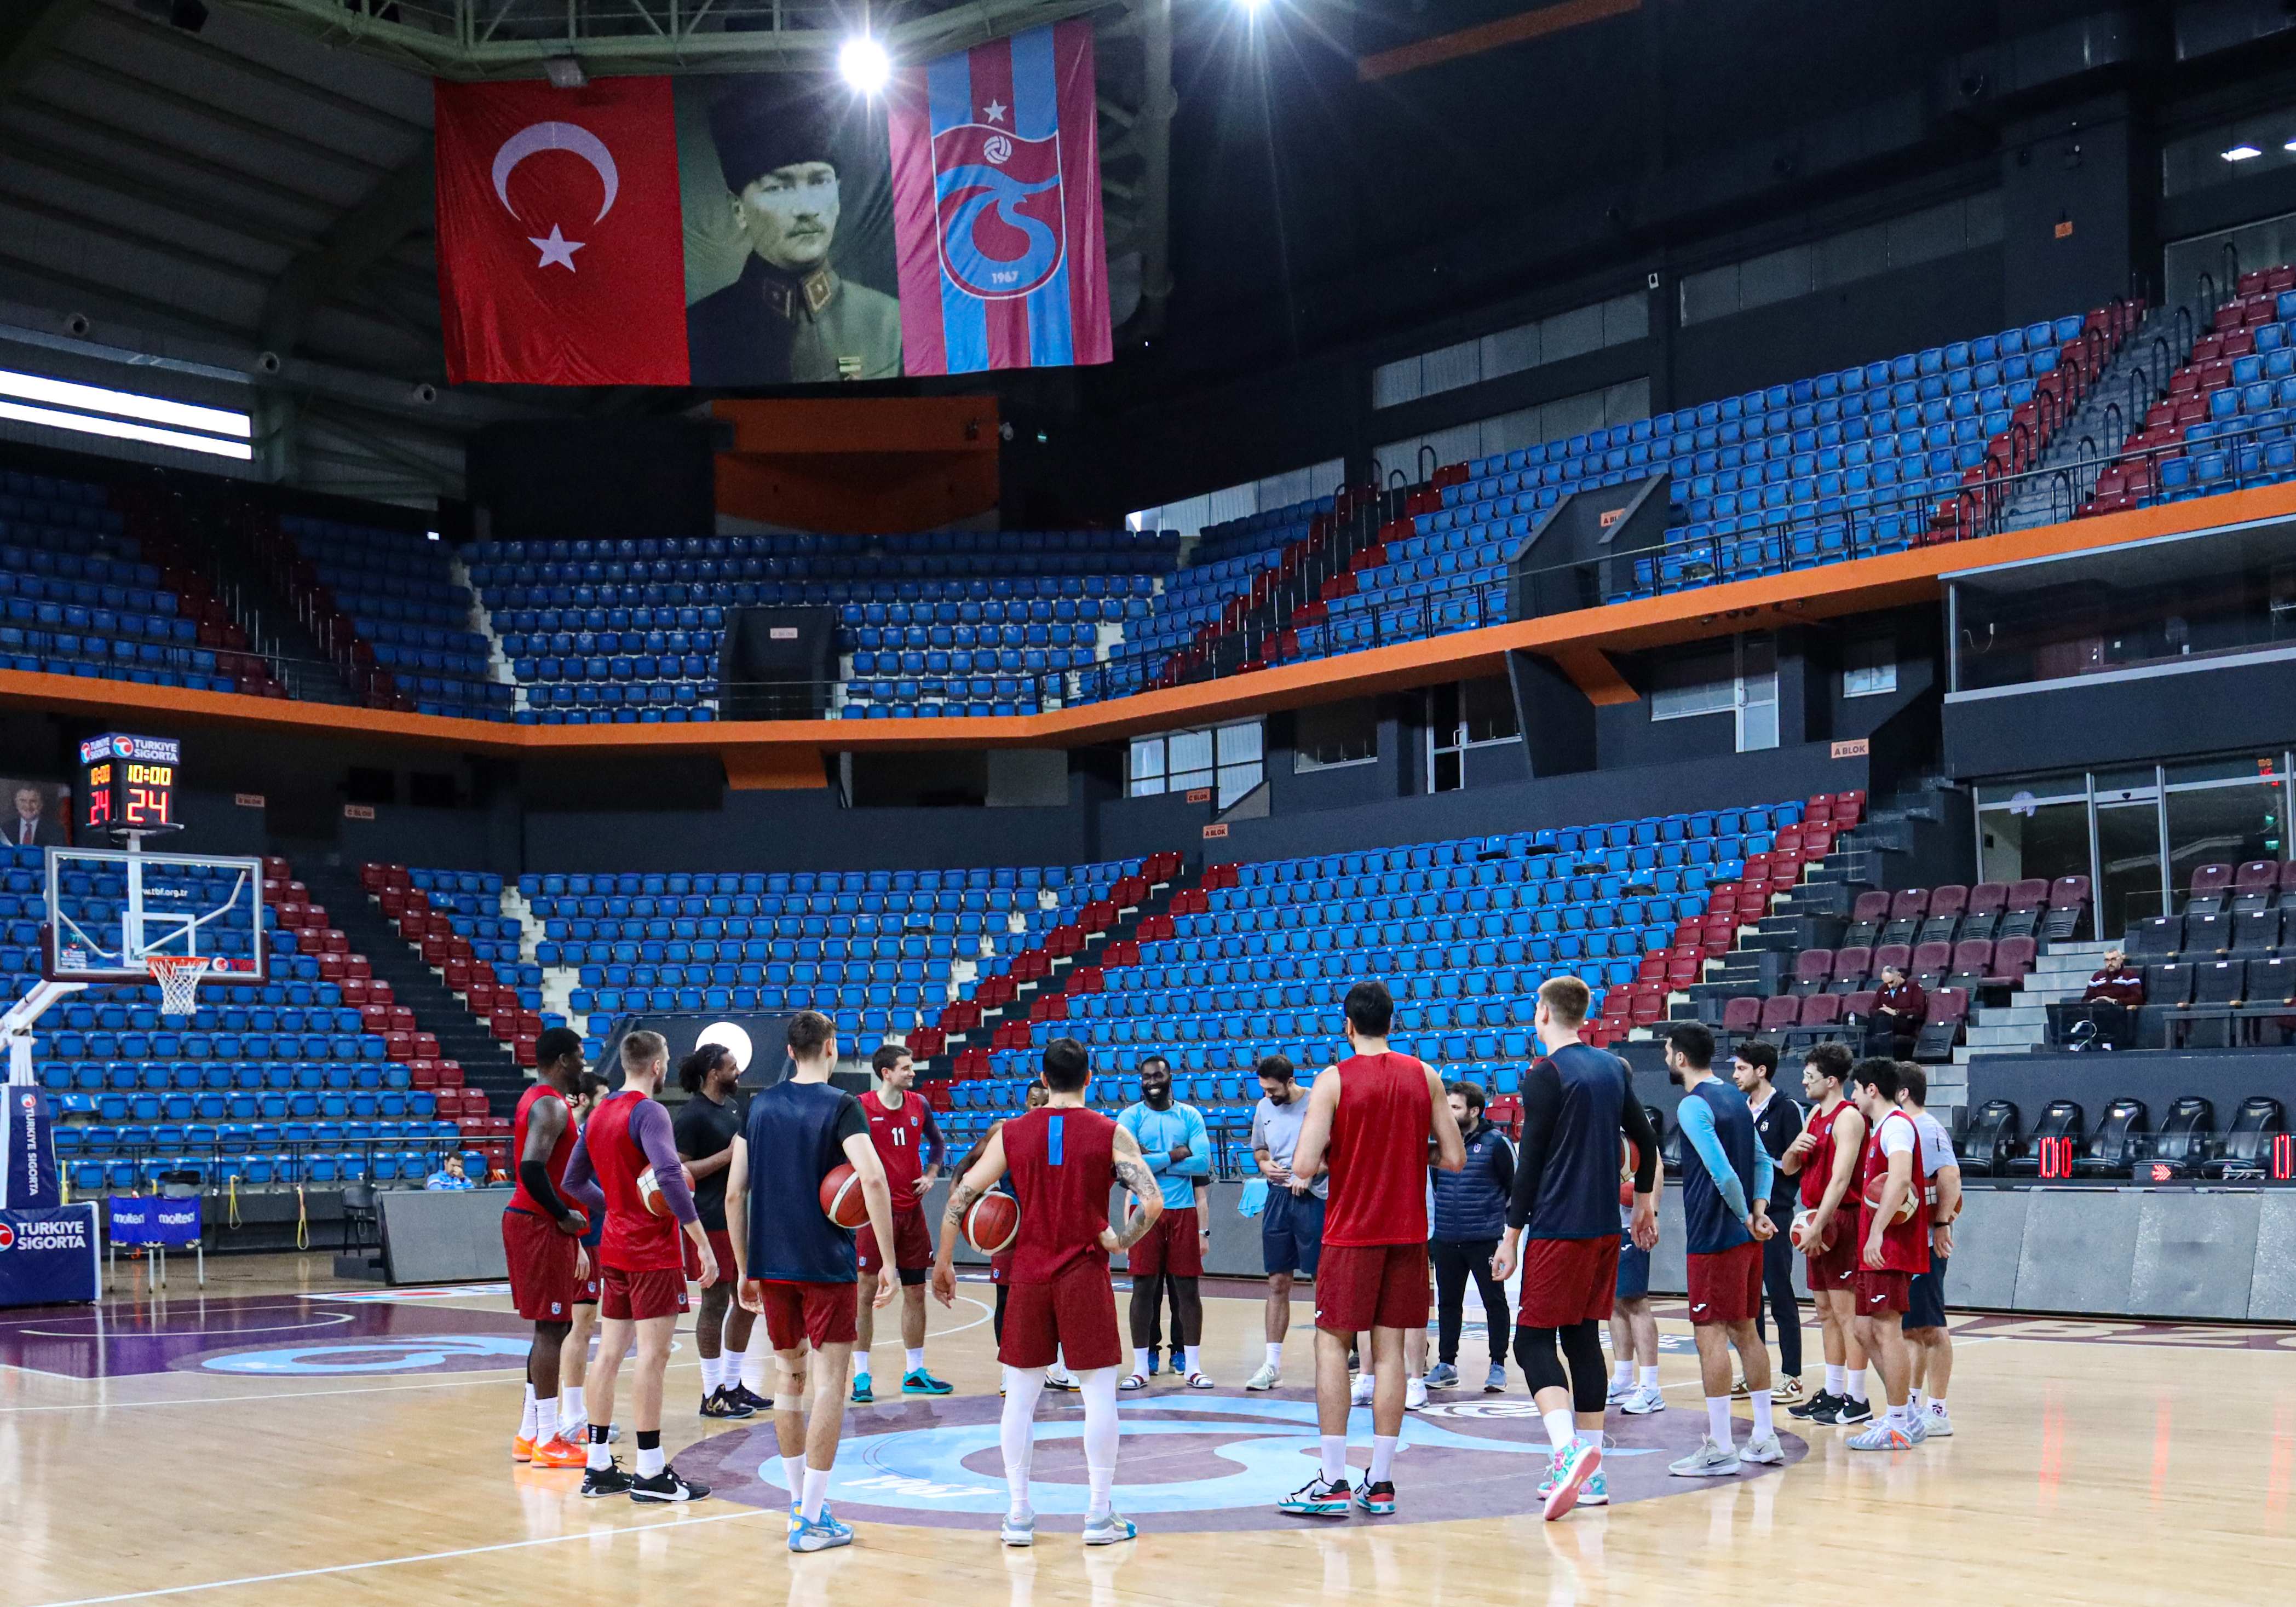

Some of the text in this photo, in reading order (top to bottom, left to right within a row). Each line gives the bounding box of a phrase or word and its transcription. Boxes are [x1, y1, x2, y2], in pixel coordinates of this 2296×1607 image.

[992, 270, 1018, 284] 1967
[1843, 745, 1866, 754] BLOK
[128, 764, 171, 786] 10:00
[89, 789, 110, 825] 24
[126, 788, 168, 823] 24
[891, 1127, 906, 1146] 11
[113, 1212, 145, 1224] molten
[158, 1211, 195, 1224] molten
[839, 1474, 1007, 1499] 1967
